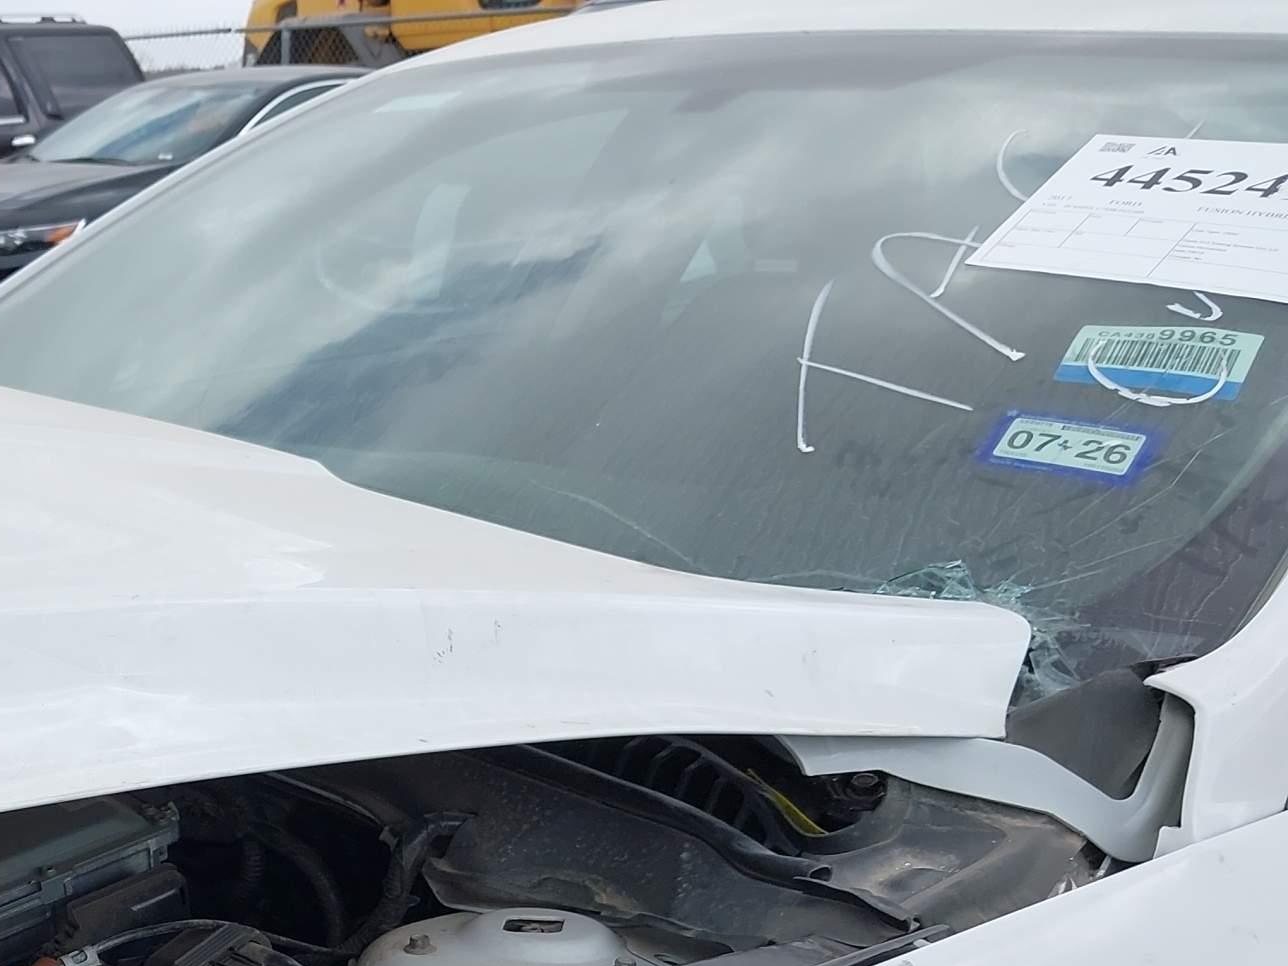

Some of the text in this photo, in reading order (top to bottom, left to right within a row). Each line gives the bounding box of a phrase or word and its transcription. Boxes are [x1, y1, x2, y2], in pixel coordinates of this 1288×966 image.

[1090, 165, 1288, 199] 44524
[1007, 430, 1131, 464] 07 26
